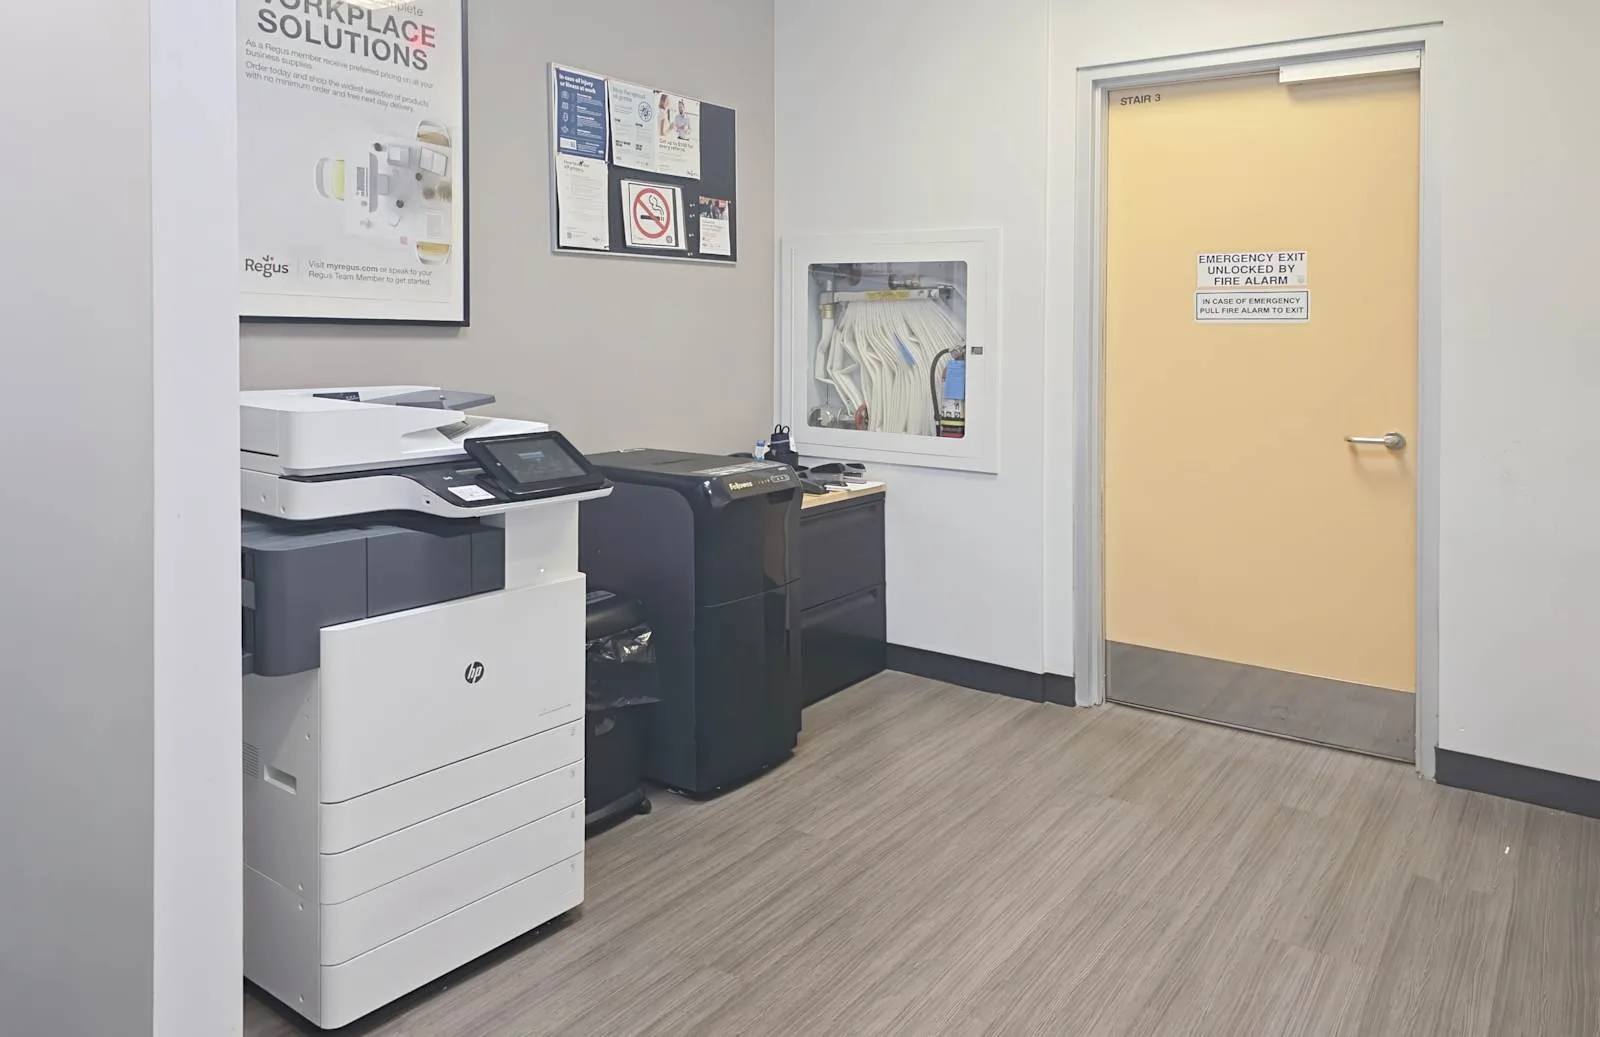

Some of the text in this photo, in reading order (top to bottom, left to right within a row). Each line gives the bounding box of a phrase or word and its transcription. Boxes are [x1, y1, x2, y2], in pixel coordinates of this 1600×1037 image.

[257, 8, 428, 71] SOLUTIONS
[246, 48, 281, 62] business
[265, 43, 290, 56] Regus
[291, 50, 322, 63] member
[381, 71, 401, 83] pricing
[420, 81, 434, 89] your
[246, 60, 268, 73] Order
[270, 66, 292, 79] today
[293, 71, 308, 80] and
[309, 75, 327, 86] shop
[329, 79, 340, 88] the
[341, 82, 364, 94] widest
[365, 87, 394, 99] selection
[245, 71, 262, 81] with
[263, 75, 274, 83] no
[275, 78, 311, 90] minimum
[312, 84, 330, 94] order
[332, 89, 346, 98] and
[347, 91, 360, 101] free
[361, 95, 376, 104] next
[376, 99, 389, 109] day
[1120, 93, 1161, 106] STAIR 3
[1199, 252, 1305, 264] EMERGENCY EXIT
[245, 257, 289, 278] Regus
[308, 259, 325, 269] Visit
[326, 262, 378, 273] myregus.com
[389, 266, 409, 276] speak
[419, 270, 432, 278] your
[1207, 264, 1295, 275] UNLOCKED BY
[308, 270, 333, 281] Regus
[335, 272, 354, 281] Team
[356, 273, 385, 283] Member
[387, 275, 394, 284] to
[395, 277, 406, 286] get
[1214, 276, 1288, 286] FIRE ALARM
[1249, 297, 1301, 305] EMERGENCY
[1272, 306, 1284, 314] TO
